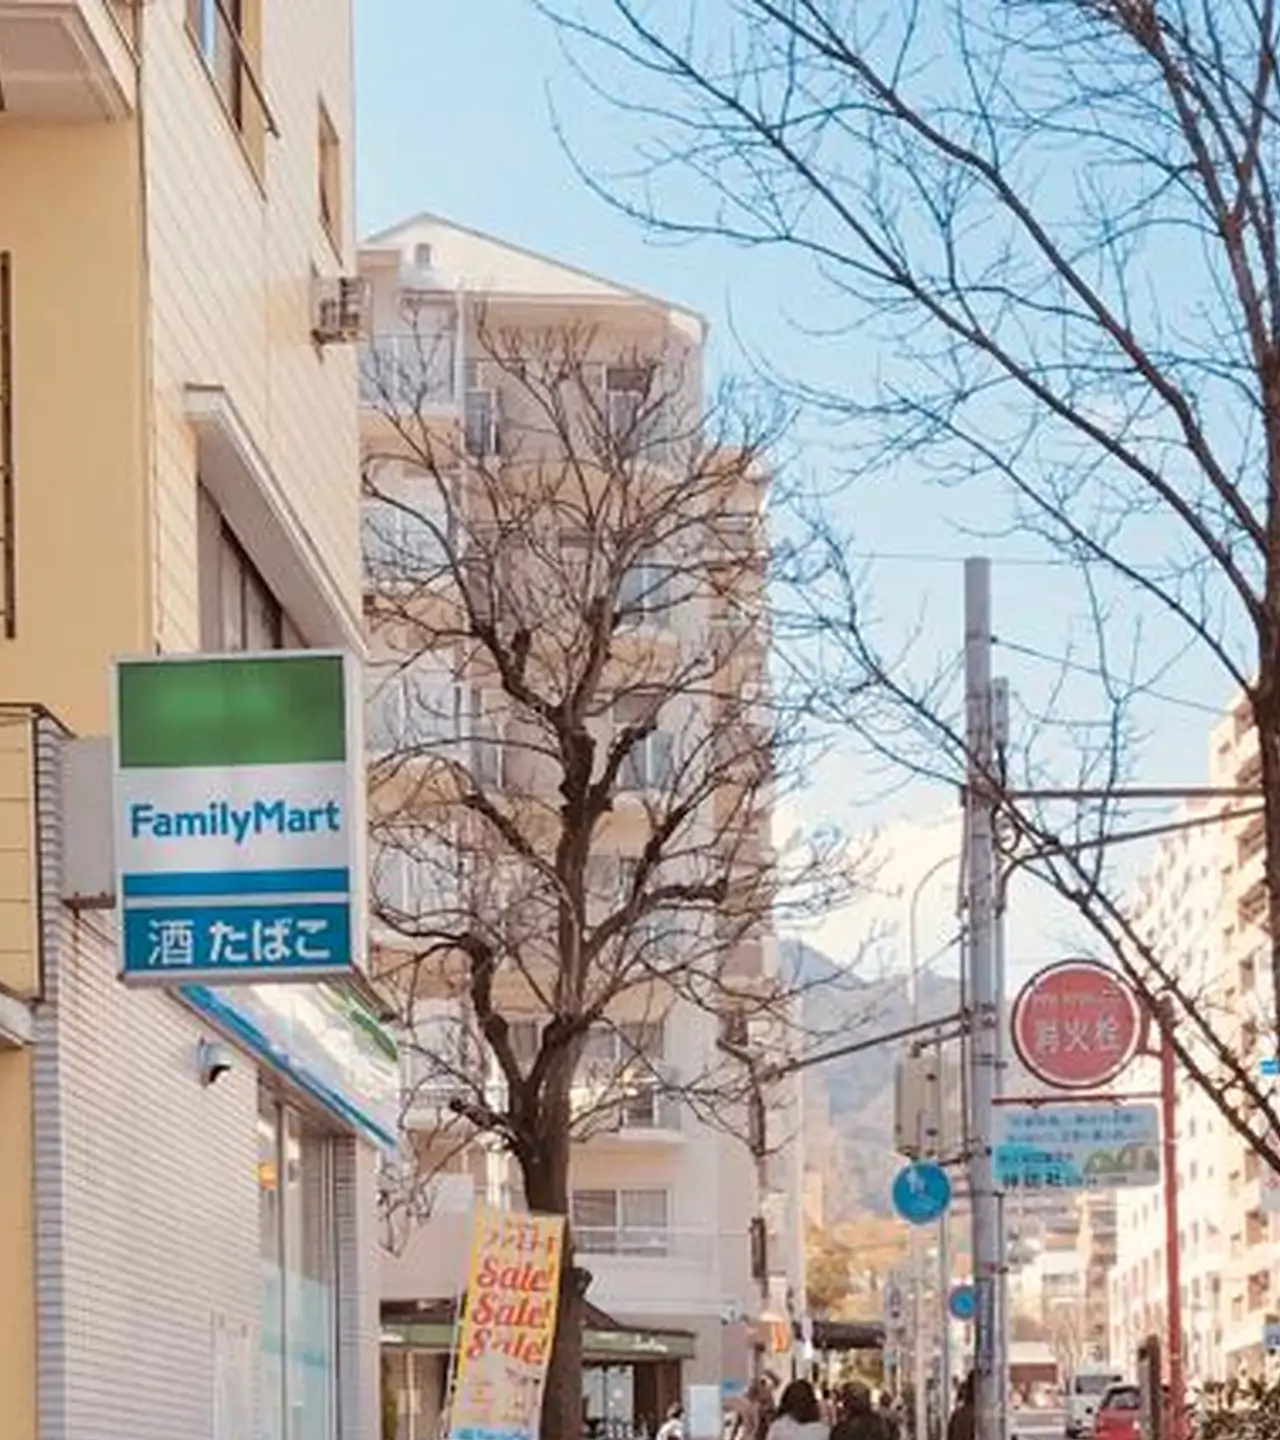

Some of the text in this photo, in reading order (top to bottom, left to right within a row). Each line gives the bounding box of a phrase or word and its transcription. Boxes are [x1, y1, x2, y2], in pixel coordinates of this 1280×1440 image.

[129, 800, 340, 843] FamilyMart
[149, 918, 331, 965] 酒 たばこ
